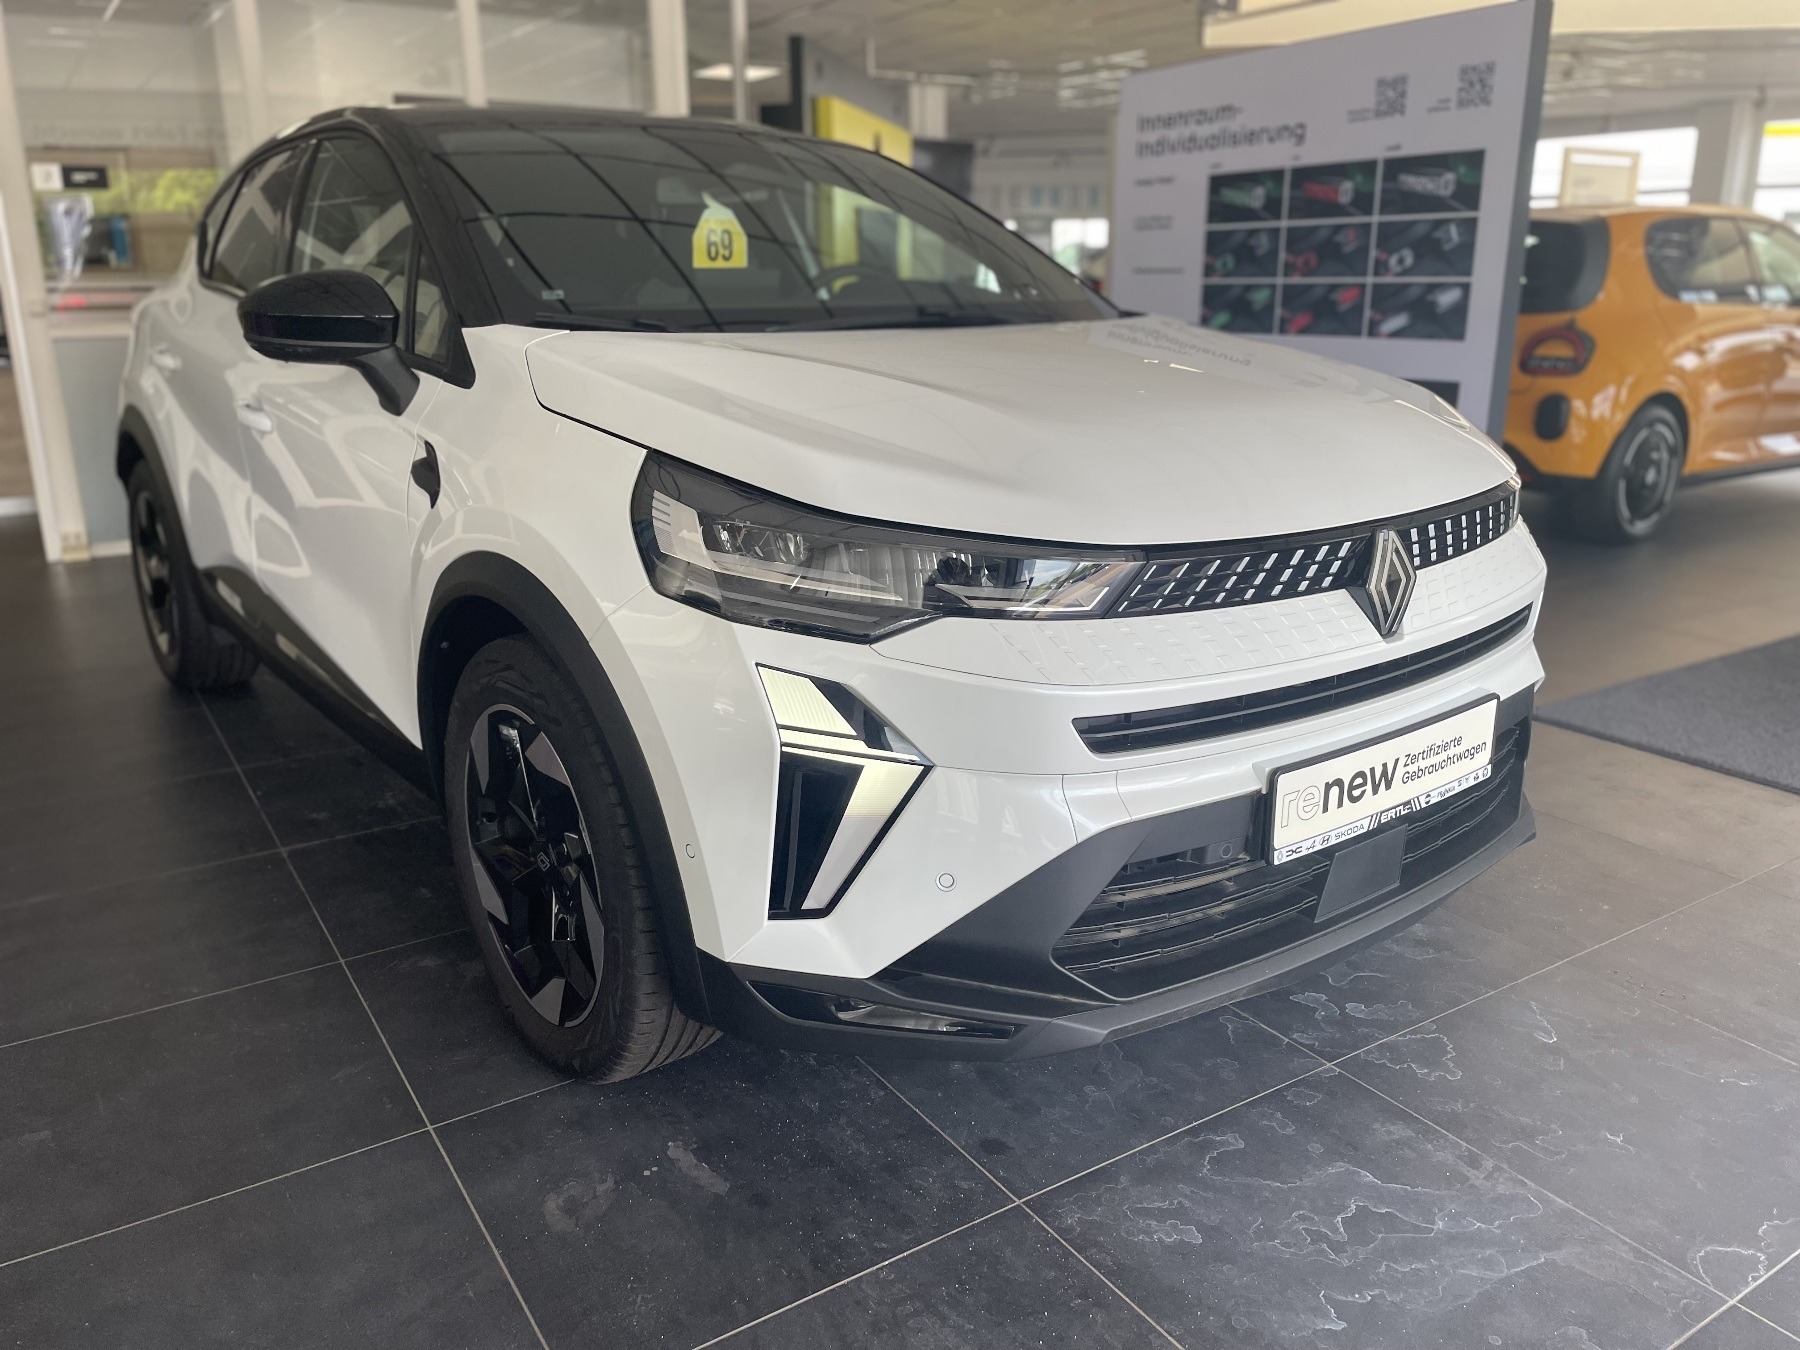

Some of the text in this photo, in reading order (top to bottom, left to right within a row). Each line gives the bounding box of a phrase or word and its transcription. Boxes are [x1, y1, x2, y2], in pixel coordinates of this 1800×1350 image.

[706, 228, 734, 262] 69
[1401, 741, 1487, 784] Gebrauchtwagen
[1403, 735, 1463, 767] Zertifizierte
[1281, 757, 1400, 829] renew
